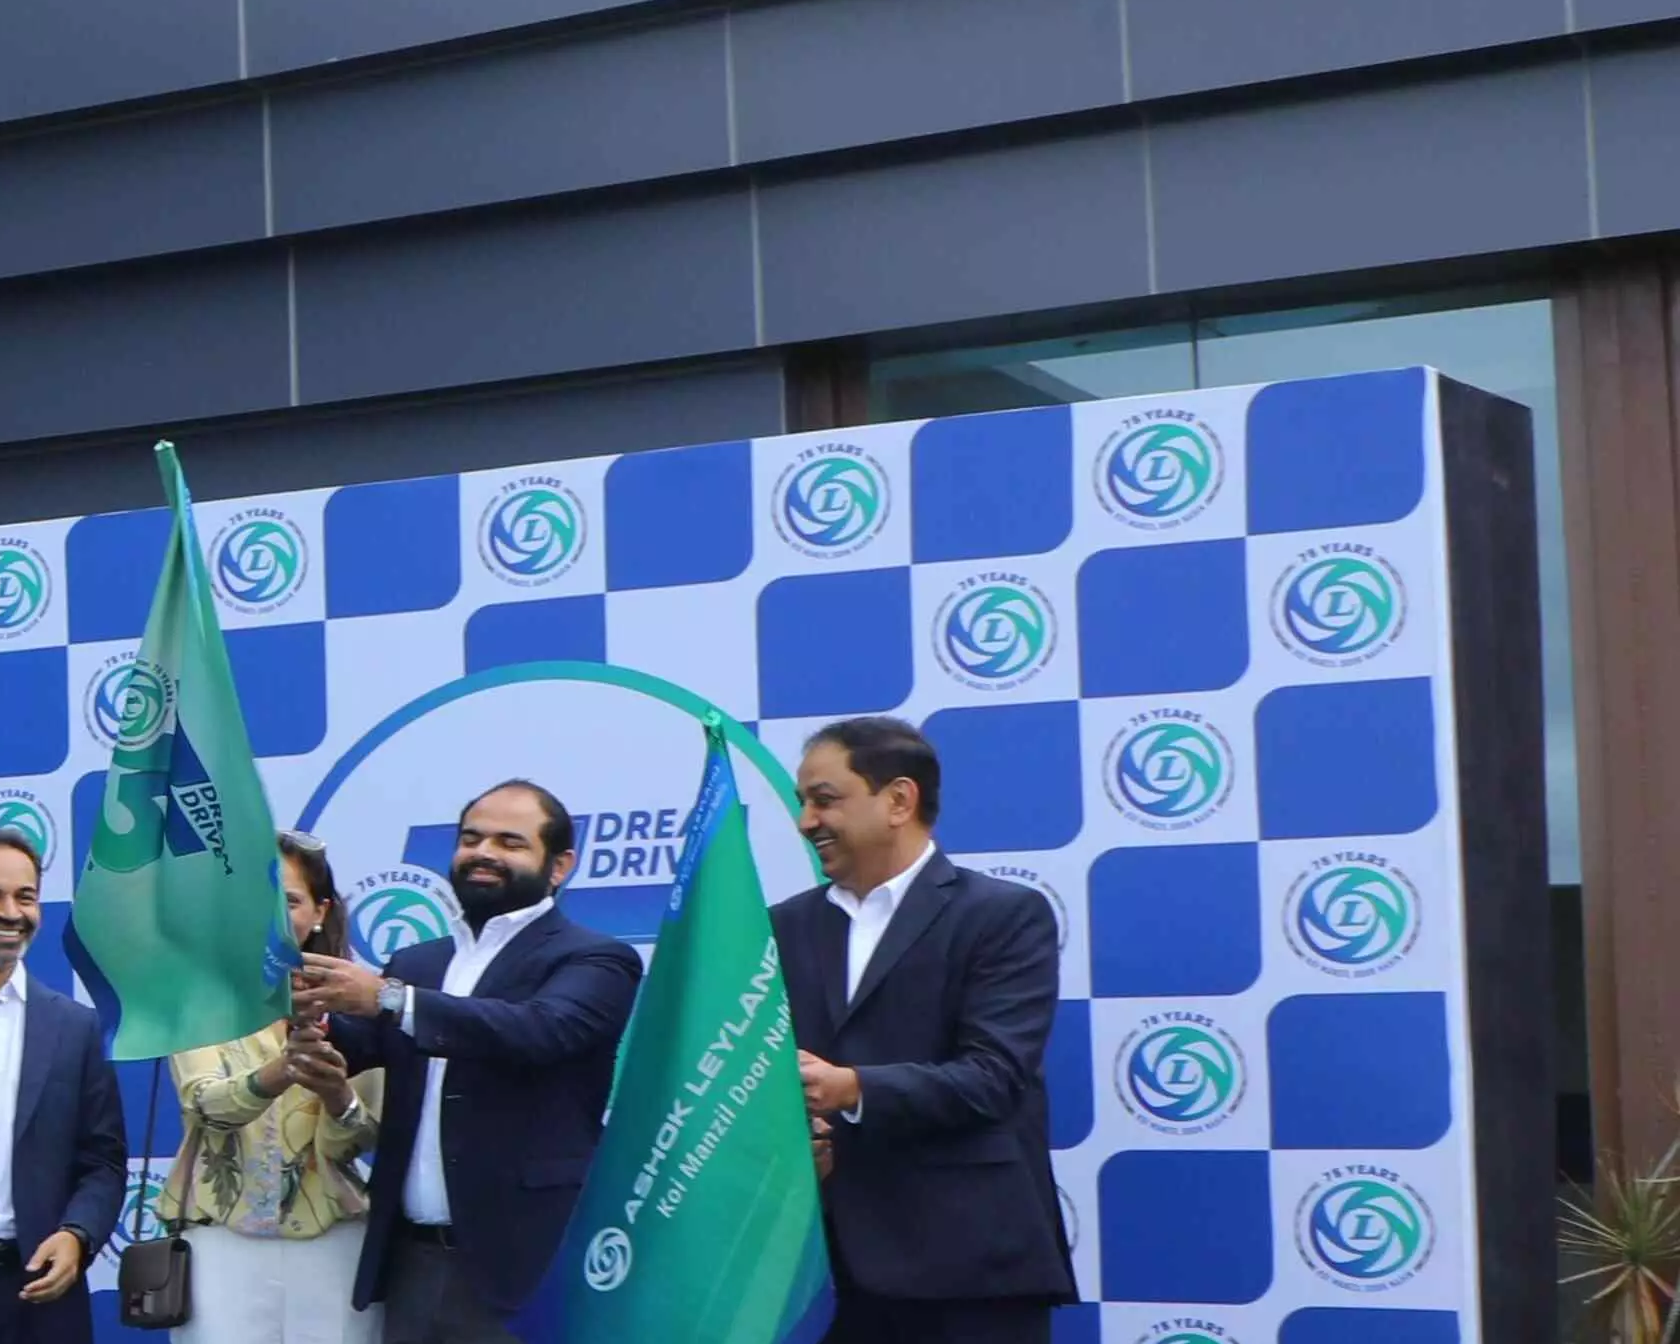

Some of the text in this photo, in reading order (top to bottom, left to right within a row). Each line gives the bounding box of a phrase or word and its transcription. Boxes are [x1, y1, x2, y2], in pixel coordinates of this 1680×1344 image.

[1144, 409, 1195, 422] YEARS
[817, 444, 863, 456] YEARS
[521, 477, 561, 488] YEARS
[245, 508, 284, 519] YEARS
[1321, 543, 1373, 557] YEARS
[978, 572, 1028, 585] YEARS
[1151, 709, 1202, 723] YEARS
[0, 789, 34, 802] YEARS
[594, 808, 697, 842] DRE
[588, 844, 679, 878] DRI
[1334, 852, 1385, 867] YEARS
[379, 871, 431, 888] YEARS
[1162, 1012, 1214, 1027] YEARS
[656, 989, 793, 1220] Koi Manzil Door Nah
[624, 1098, 695, 1224] ASHOK
[1347, 1165, 1399, 1182] YEARS
[1174, 1318, 1224, 1335] YEARS
